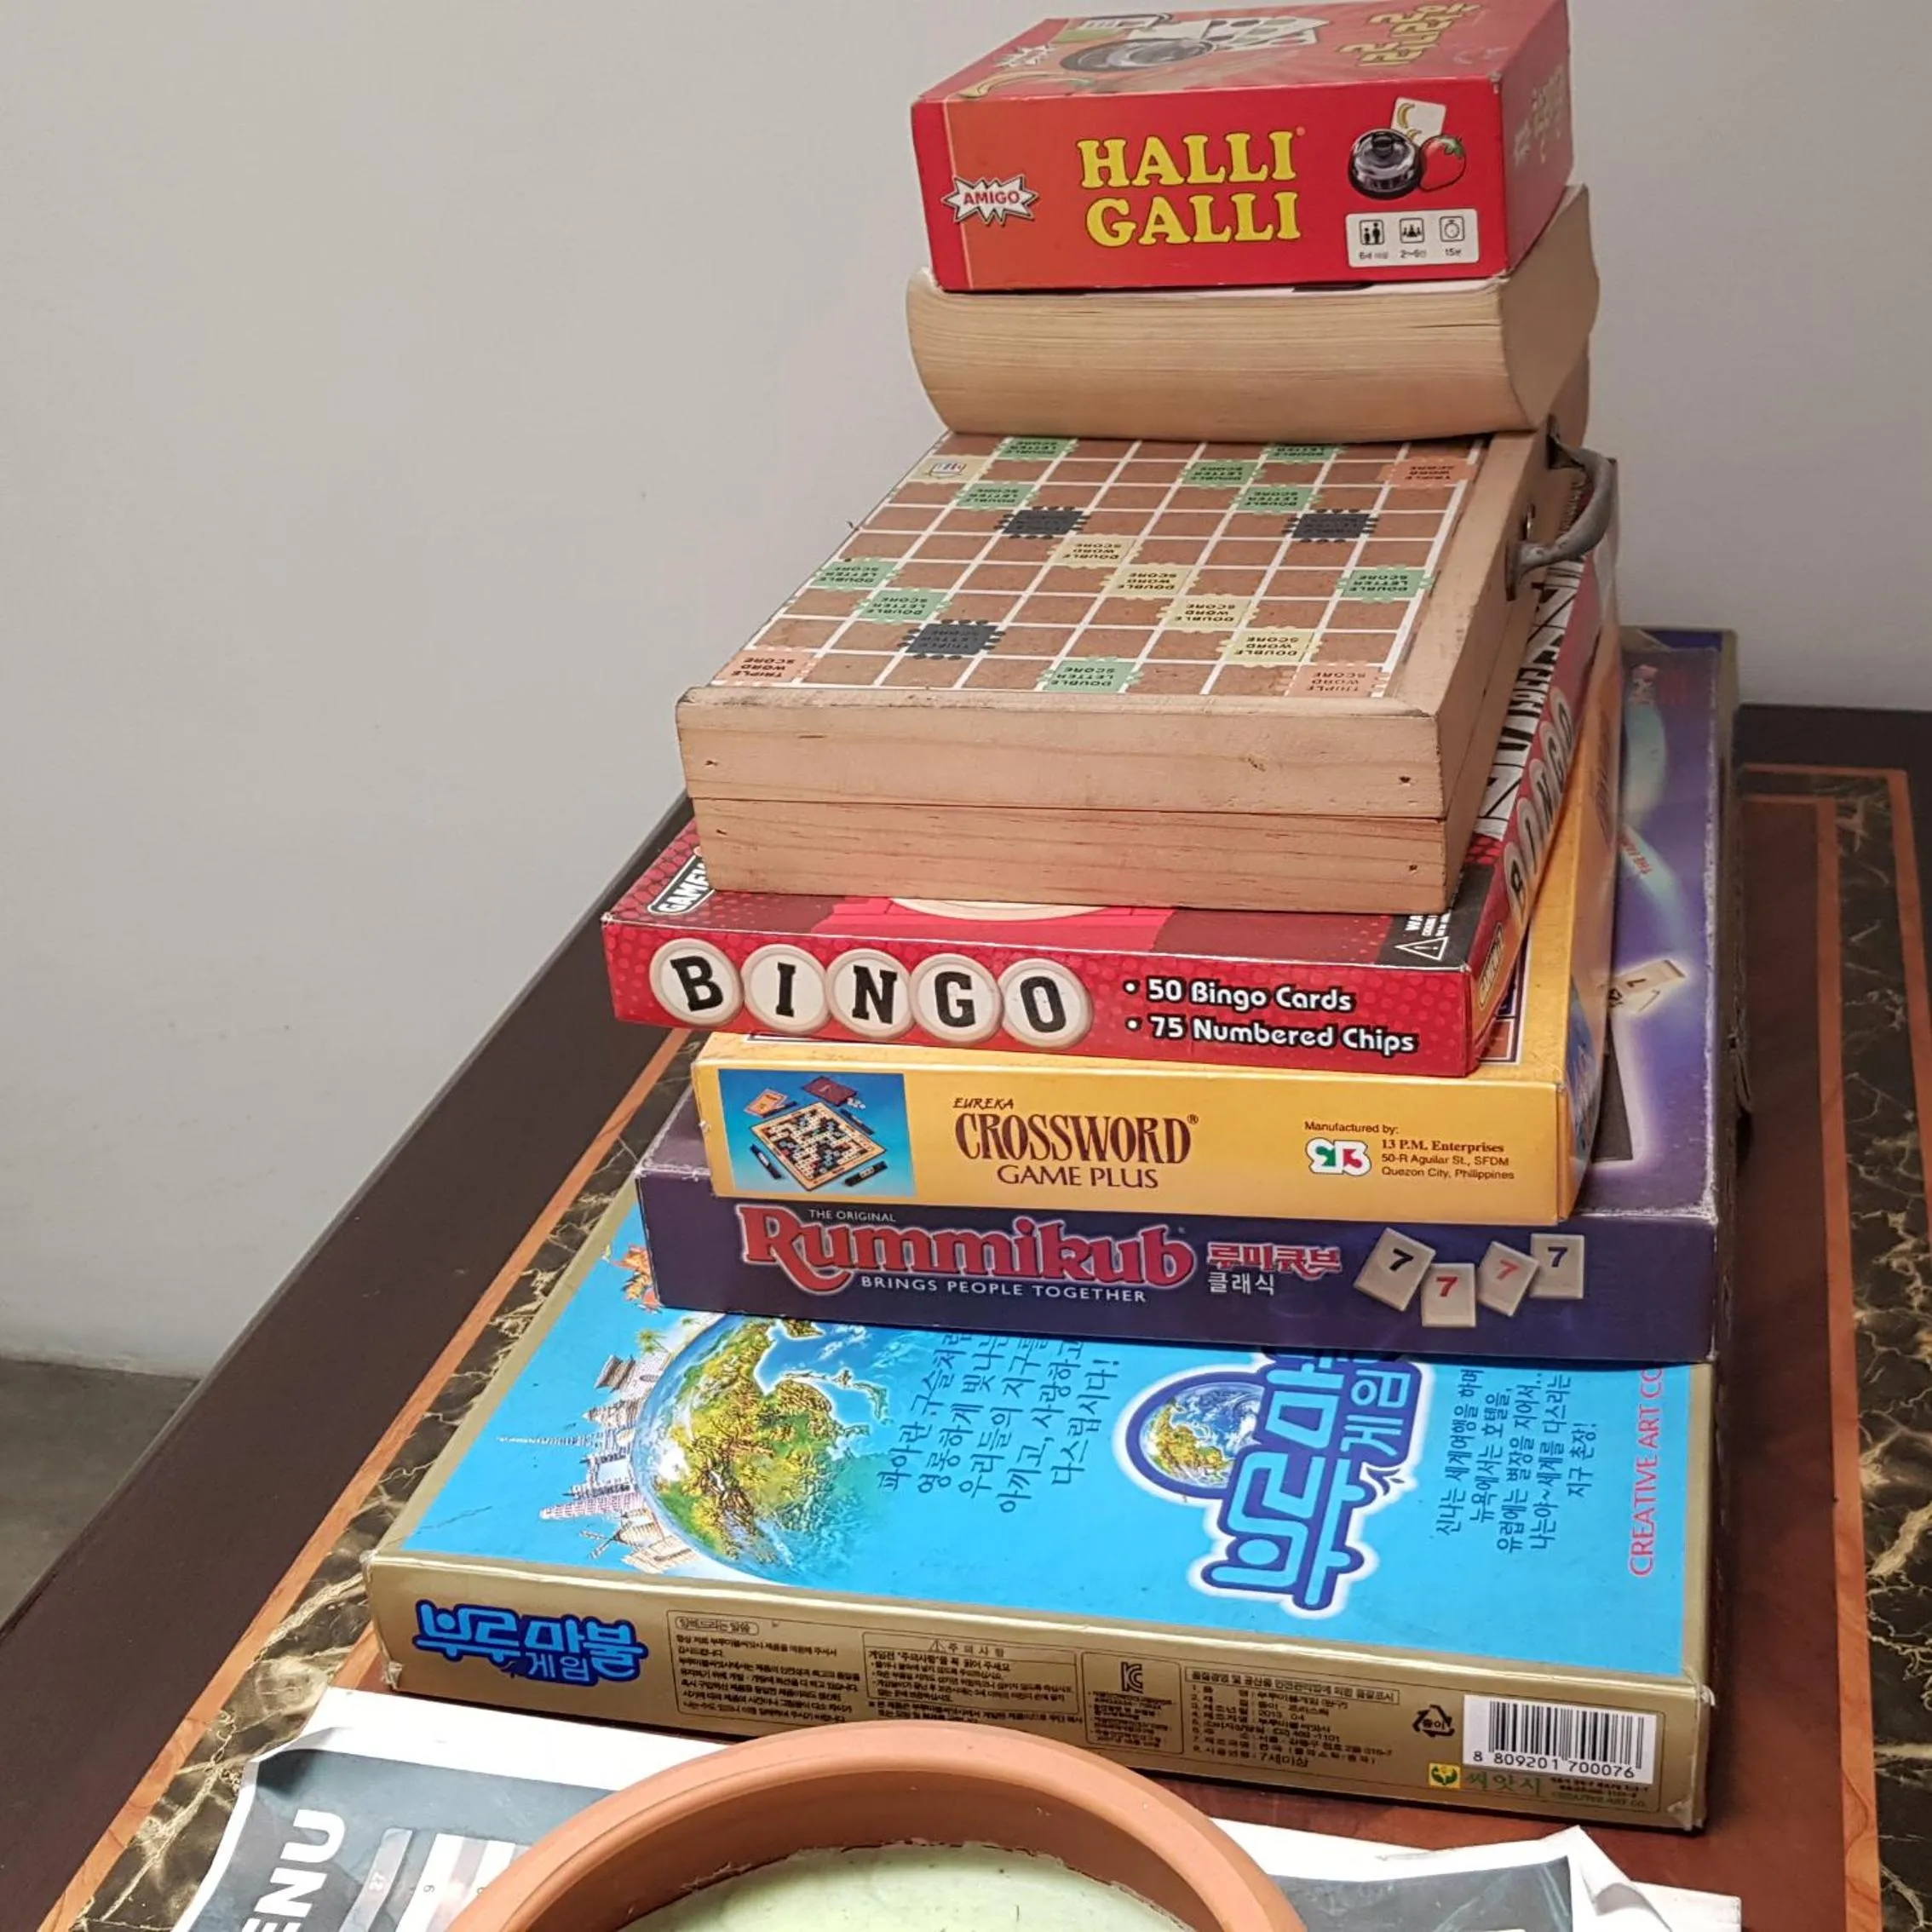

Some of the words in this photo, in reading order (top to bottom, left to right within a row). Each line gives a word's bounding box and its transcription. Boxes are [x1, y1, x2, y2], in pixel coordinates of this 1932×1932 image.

[1076, 130, 1297, 189] HALLI
[963, 190, 1021, 205] AMIGO
[1085, 191, 1301, 248] GALLI
[670, 954, 1067, 1033] BINGO
[1147, 977, 1182, 1003] 50
[1190, 980, 1268, 1012] Bingo
[1275, 985, 1354, 1012] Cards
[1149, 1015, 1184, 1039] 75
[1192, 1019, 1335, 1049] Numbered
[1341, 1026, 1417, 1057] Chips
[952, 1095, 1015, 1110] EUREKA
[954, 1113, 1192, 1164] CROSSWORD
[1304, 1120, 1379, 1134] Manufactured
[1381, 1124, 1400, 1135] by:
[1381, 1139, 1396, 1150] 13
[1399, 1140, 1429, 1150] P.M.
[1431, 1140, 1505, 1153] Enterprises
[997, 1164, 1082, 1187] GAME
[1090, 1166, 1159, 1189] PLUS
[1381, 1166, 1425, 1177] Quezon
[1455, 1169, 1515, 1181] Philippines
[1411, 1154, 1450, 1166] Aguilar
[808, 1209, 833, 1220] THE
[836, 1210, 897, 1222] ORIGINAL
[735, 1202, 1197, 1296] Rummikub
[1206, 1241, 1343, 1281] 루미큐브
[1389, 1247, 1415, 1272] 7
[1496, 1258, 1521, 1281] 7
[1547, 1246, 1569, 1268] 7
[860, 1275, 938, 1292] BRINGS
[946, 1279, 1024, 1297] PEOPLE
[1031, 1284, 1147, 1303] TOGETHER
[1208, 1271, 1275, 1297] 클래식
[1435, 1275, 1458, 1298] 7
[1458, 1368, 1486, 1399] 하며
[1541, 1374, 1572, 1435] 다스리는
[1050, 1359, 1120, 1486] 다스립시다!
[1340, 1368, 1411, 1457] 게임
[1637, 1403, 1661, 1450] ART
[877, 1421, 933, 1492] 파아란
[917, 1403, 984, 1494] 영롱하게
[957, 1406, 1024, 1499] 우리들의
[1444, 1403, 1479, 1482] 세계여행을
[1505, 1436, 1535, 1483] 별장을
[1211, 1360, 1366, 1607] 부루마
[1469, 1444, 1504, 1523] 뉴욕에서는
[1565, 1465, 1594, 1498] 지구
[1436, 1488, 1467, 1536] 신나는
[1496, 1487, 1529, 1554] 유럽에는
[1629, 1453, 1659, 1578] CREATIVE
[415, 1602, 645, 1680] 부루마불
[523, 1650, 590, 1683] 게임
[1472, 1751, 1483, 1762] 8
[1493, 1752, 1559, 1771] 809201
[1568, 1760, 1636, 1779] 700076
